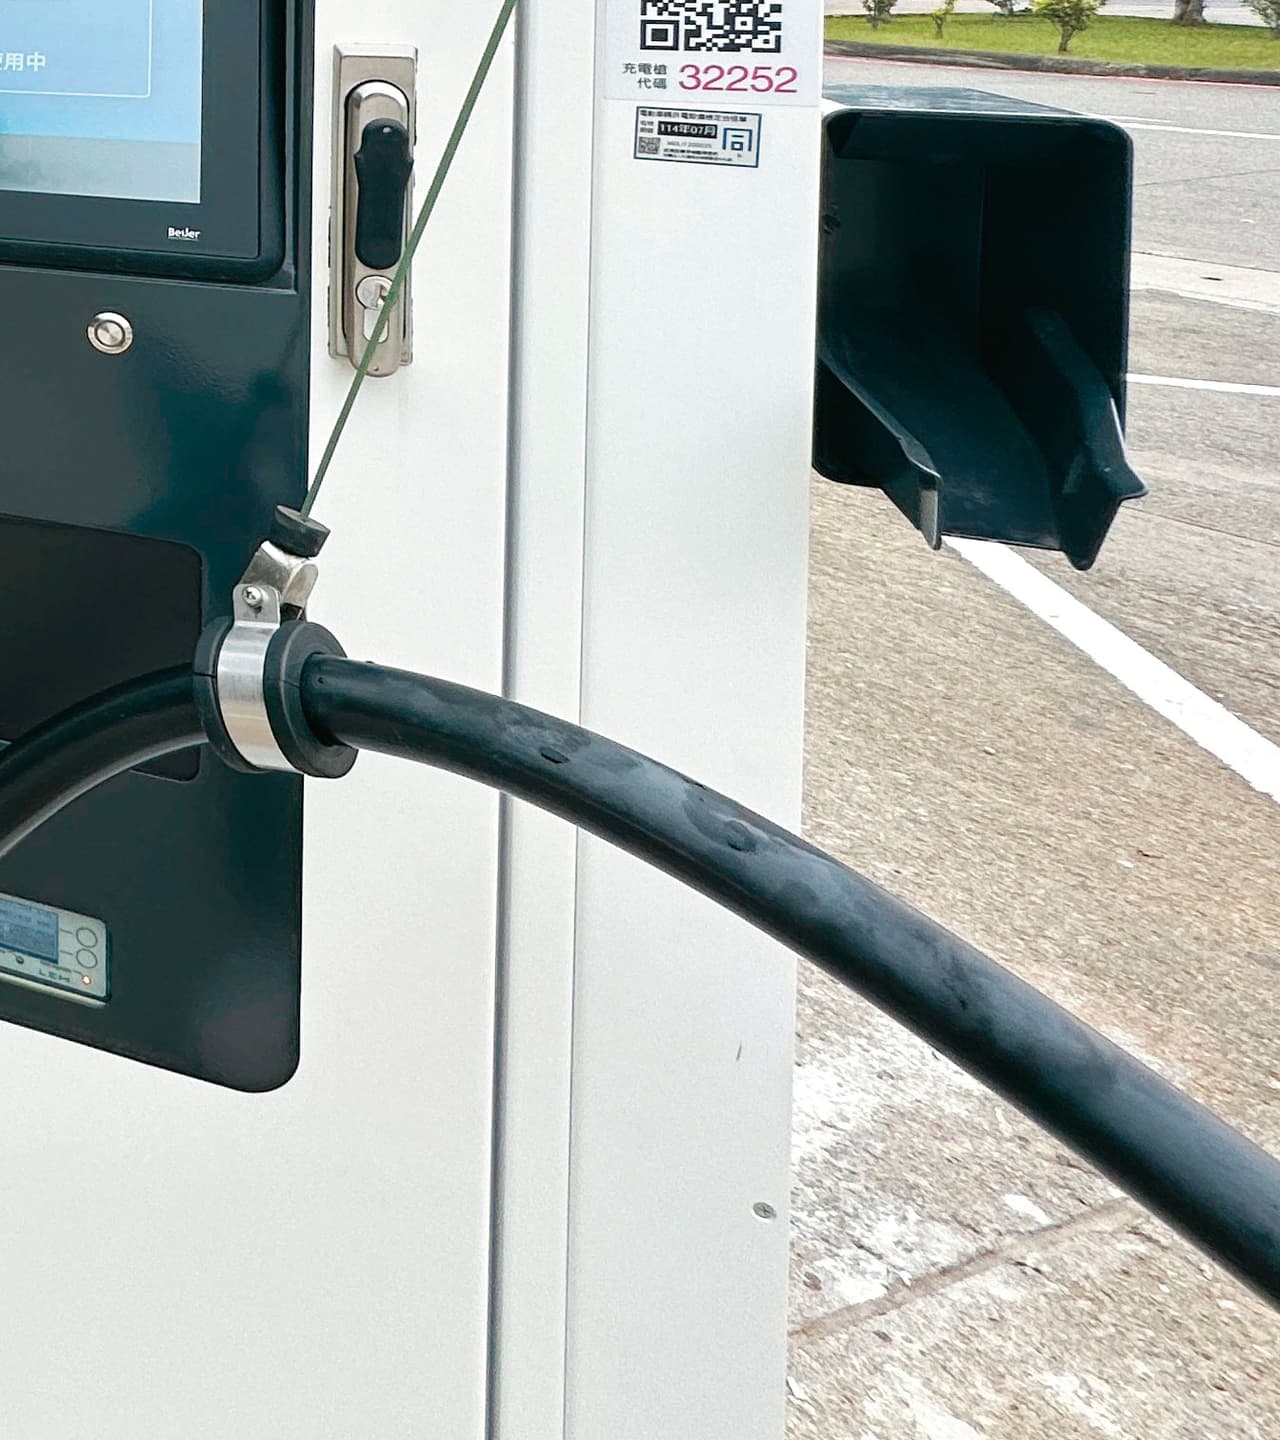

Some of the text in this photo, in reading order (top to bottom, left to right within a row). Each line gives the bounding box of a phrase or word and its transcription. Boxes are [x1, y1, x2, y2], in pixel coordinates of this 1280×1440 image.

[622, 62, 667, 75] 充電槍
[638, 77, 667, 90] 代碼
[678, 64, 798, 93] 32252
[659, 123, 717, 137] 114年07月
